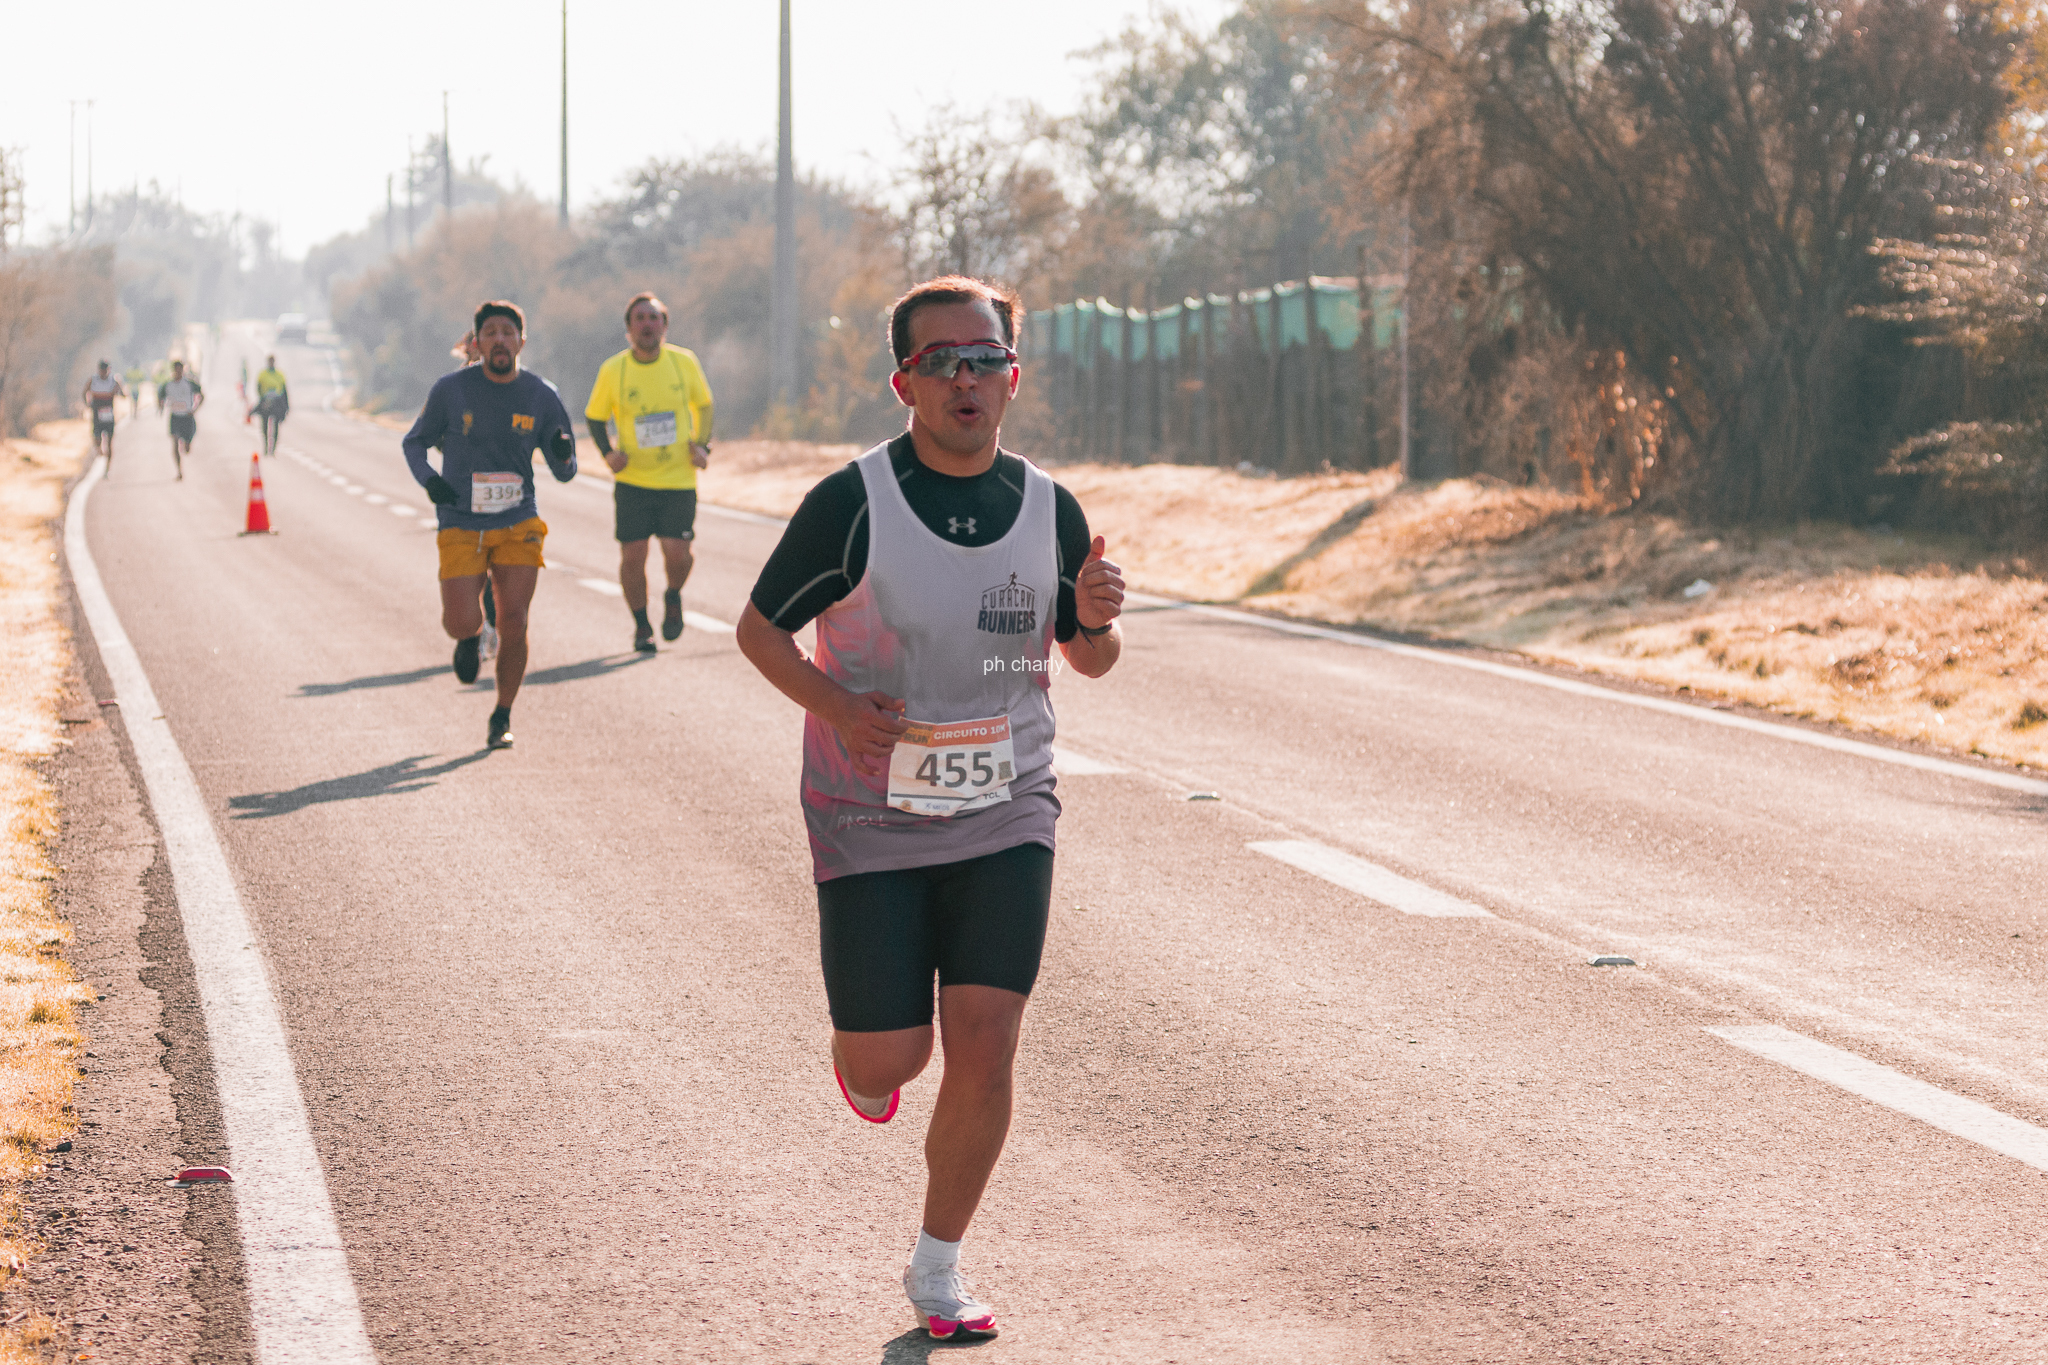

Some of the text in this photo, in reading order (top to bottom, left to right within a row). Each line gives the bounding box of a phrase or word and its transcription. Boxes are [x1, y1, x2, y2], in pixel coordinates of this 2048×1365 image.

[483, 485, 514, 500] 339
[981, 588, 1036, 610] CURACAVI
[977, 610, 1037, 635] RUNNERS
[933, 726, 988, 740] CIRCUITO
[990, 723, 1006, 735] 10K
[915, 751, 994, 788] 455
[983, 791, 1001, 800] TCL
